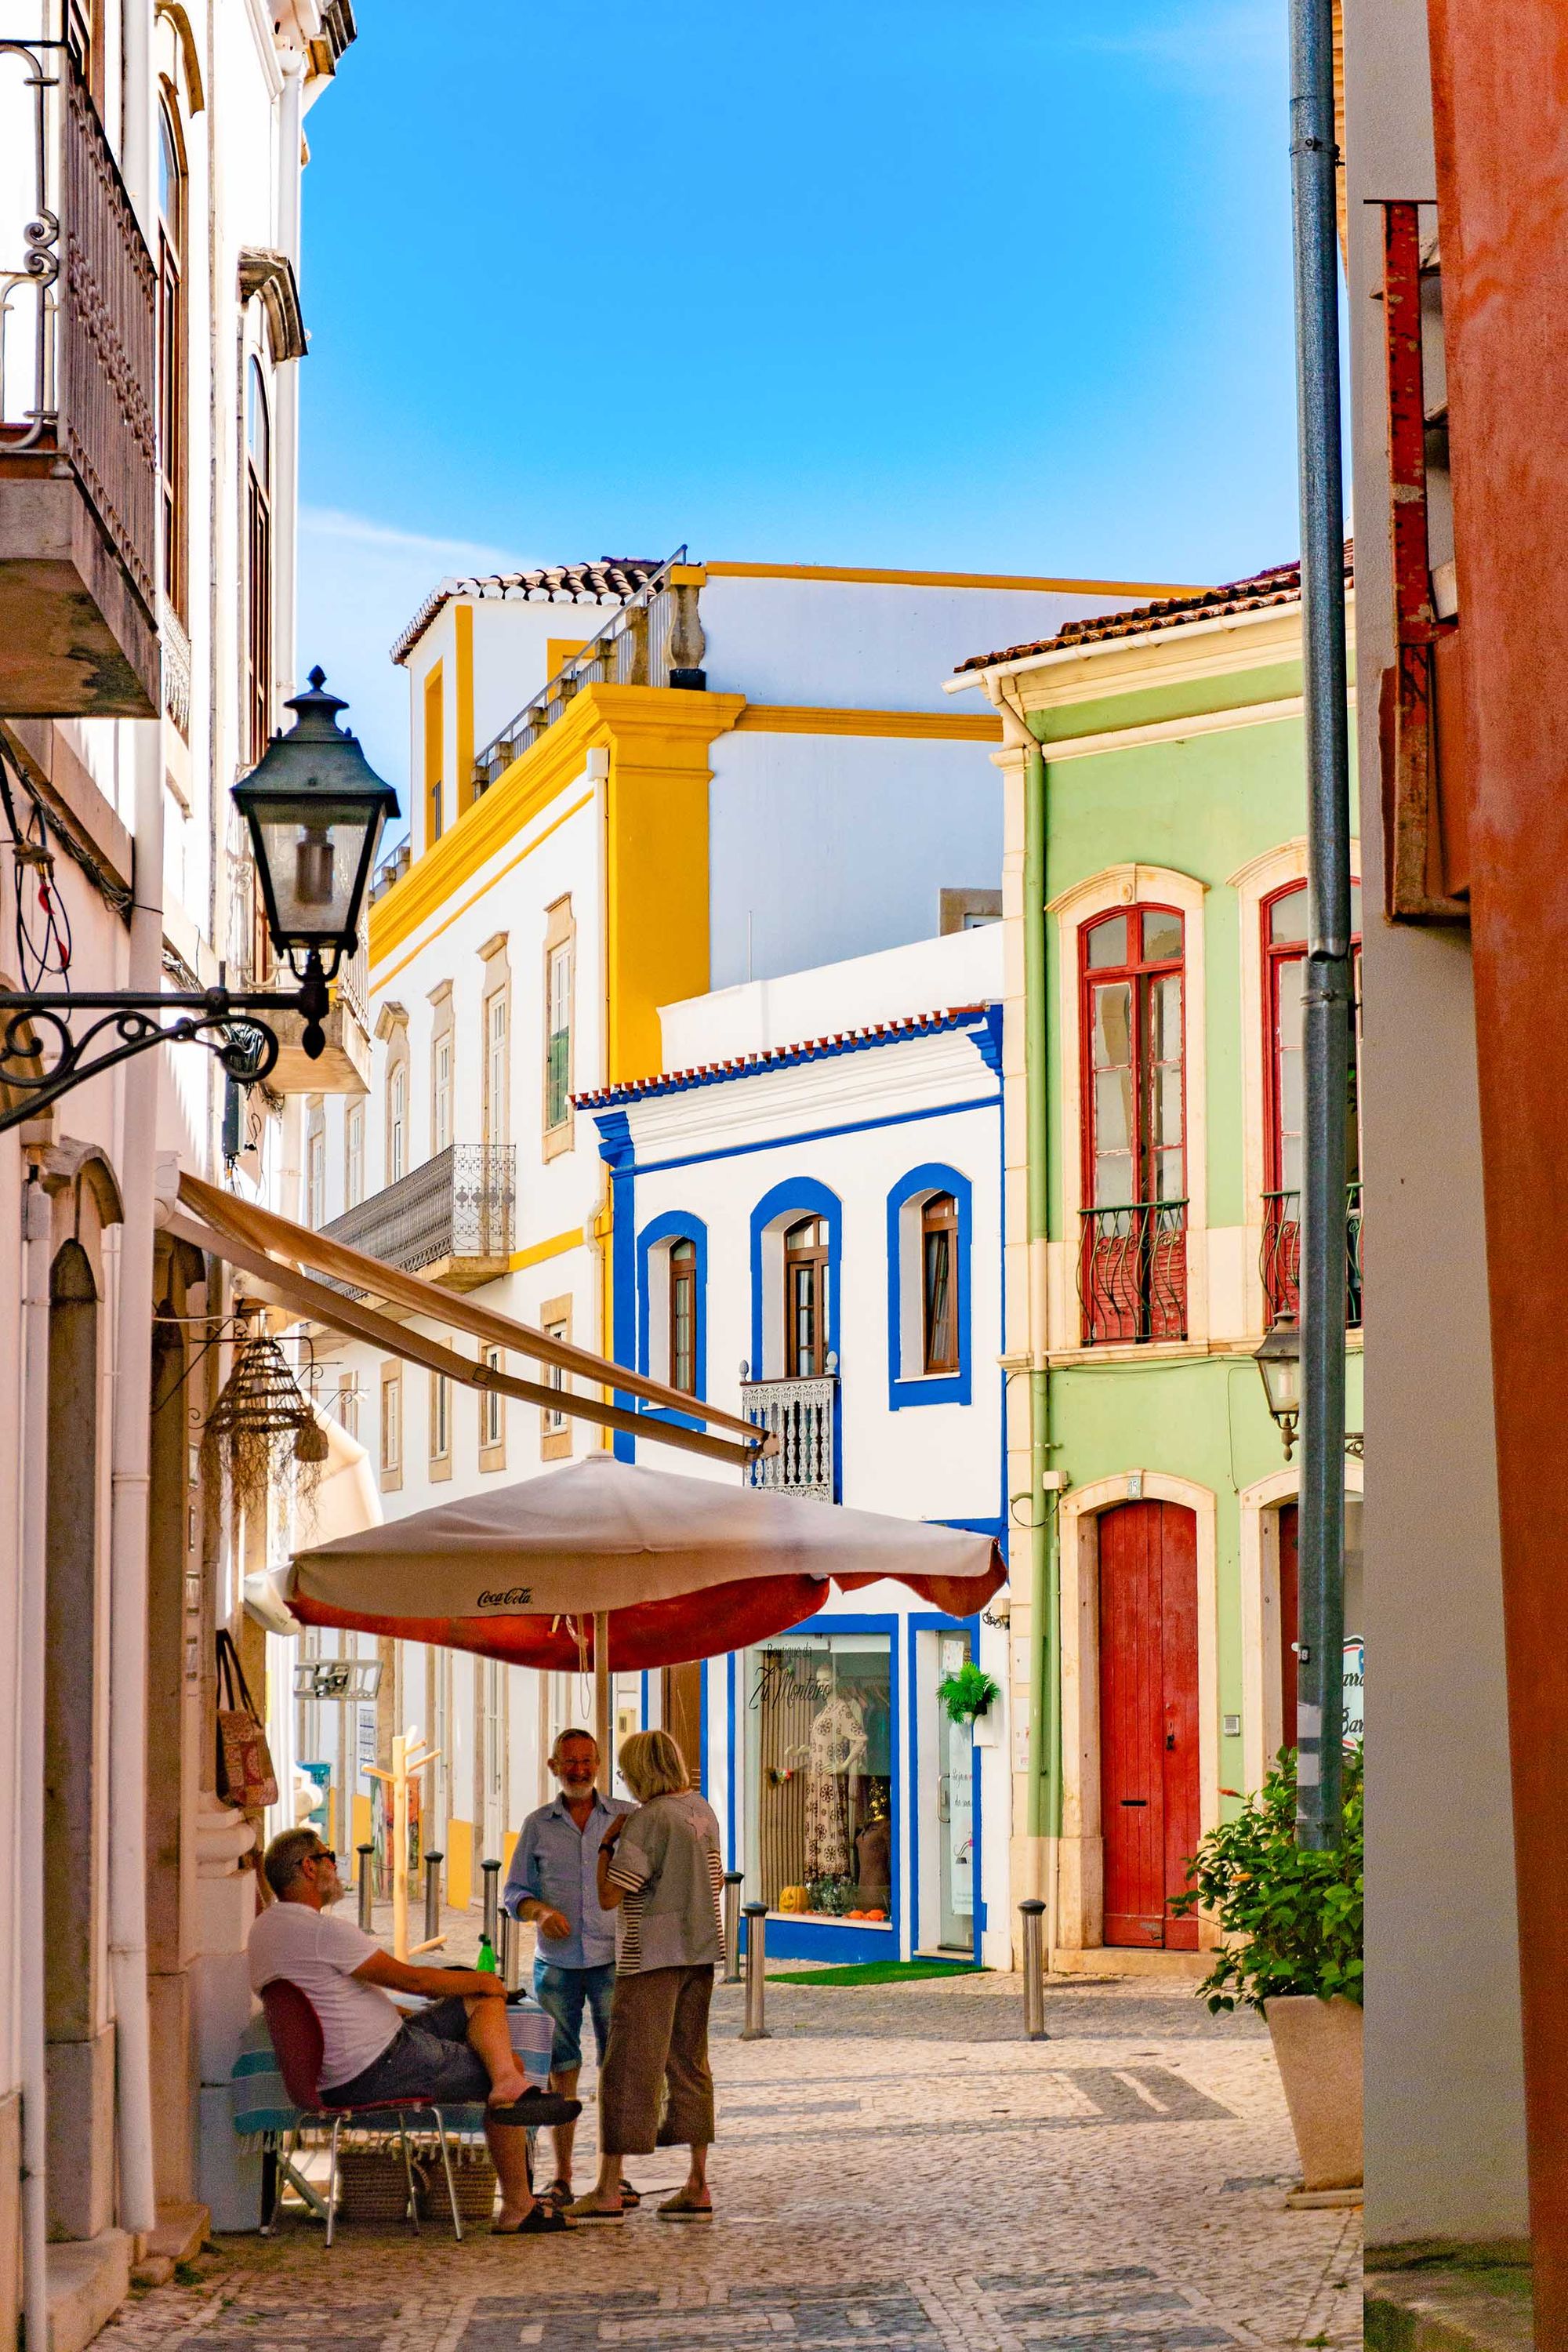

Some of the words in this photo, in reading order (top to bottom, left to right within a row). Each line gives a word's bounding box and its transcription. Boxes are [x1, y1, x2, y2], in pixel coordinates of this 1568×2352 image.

[477, 1587, 533, 1607] Coca-Cola
[767, 1642, 800, 1661] Boutique
[802, 1641, 812, 1657] da
[749, 1667, 775, 1709] Zu
[772, 1668, 831, 1709] Monteiro
